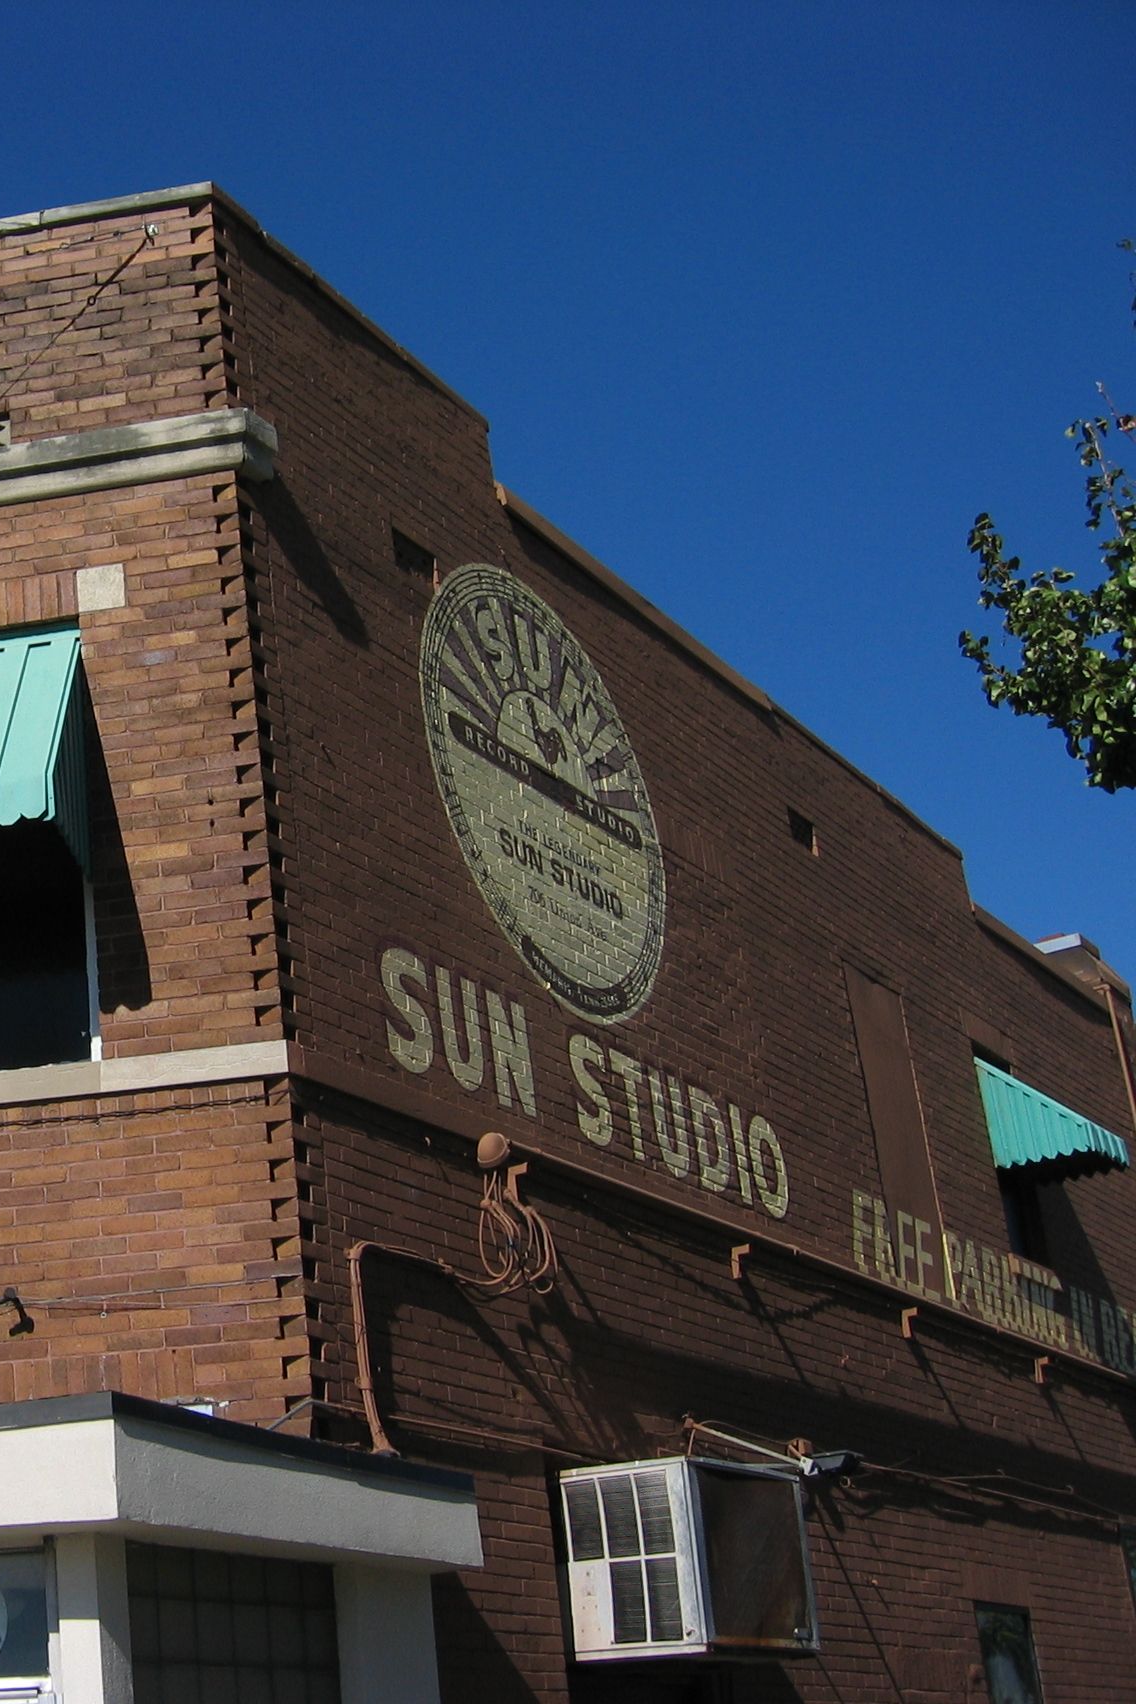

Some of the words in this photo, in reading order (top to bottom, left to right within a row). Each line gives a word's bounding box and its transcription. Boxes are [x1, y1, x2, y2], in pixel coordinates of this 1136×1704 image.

[476, 605, 608, 748] SUN
[464, 728, 530, 777] RECORD
[575, 794, 636, 843] STUDIO
[499, 827, 544, 876] SUN
[549, 856, 625, 920] STUDIO
[518, 819, 542, 844] THE
[543, 832, 602, 876] LEGENDARY
[380, 947, 538, 1118] SUN
[568, 1033, 790, 1220] STUDIO
